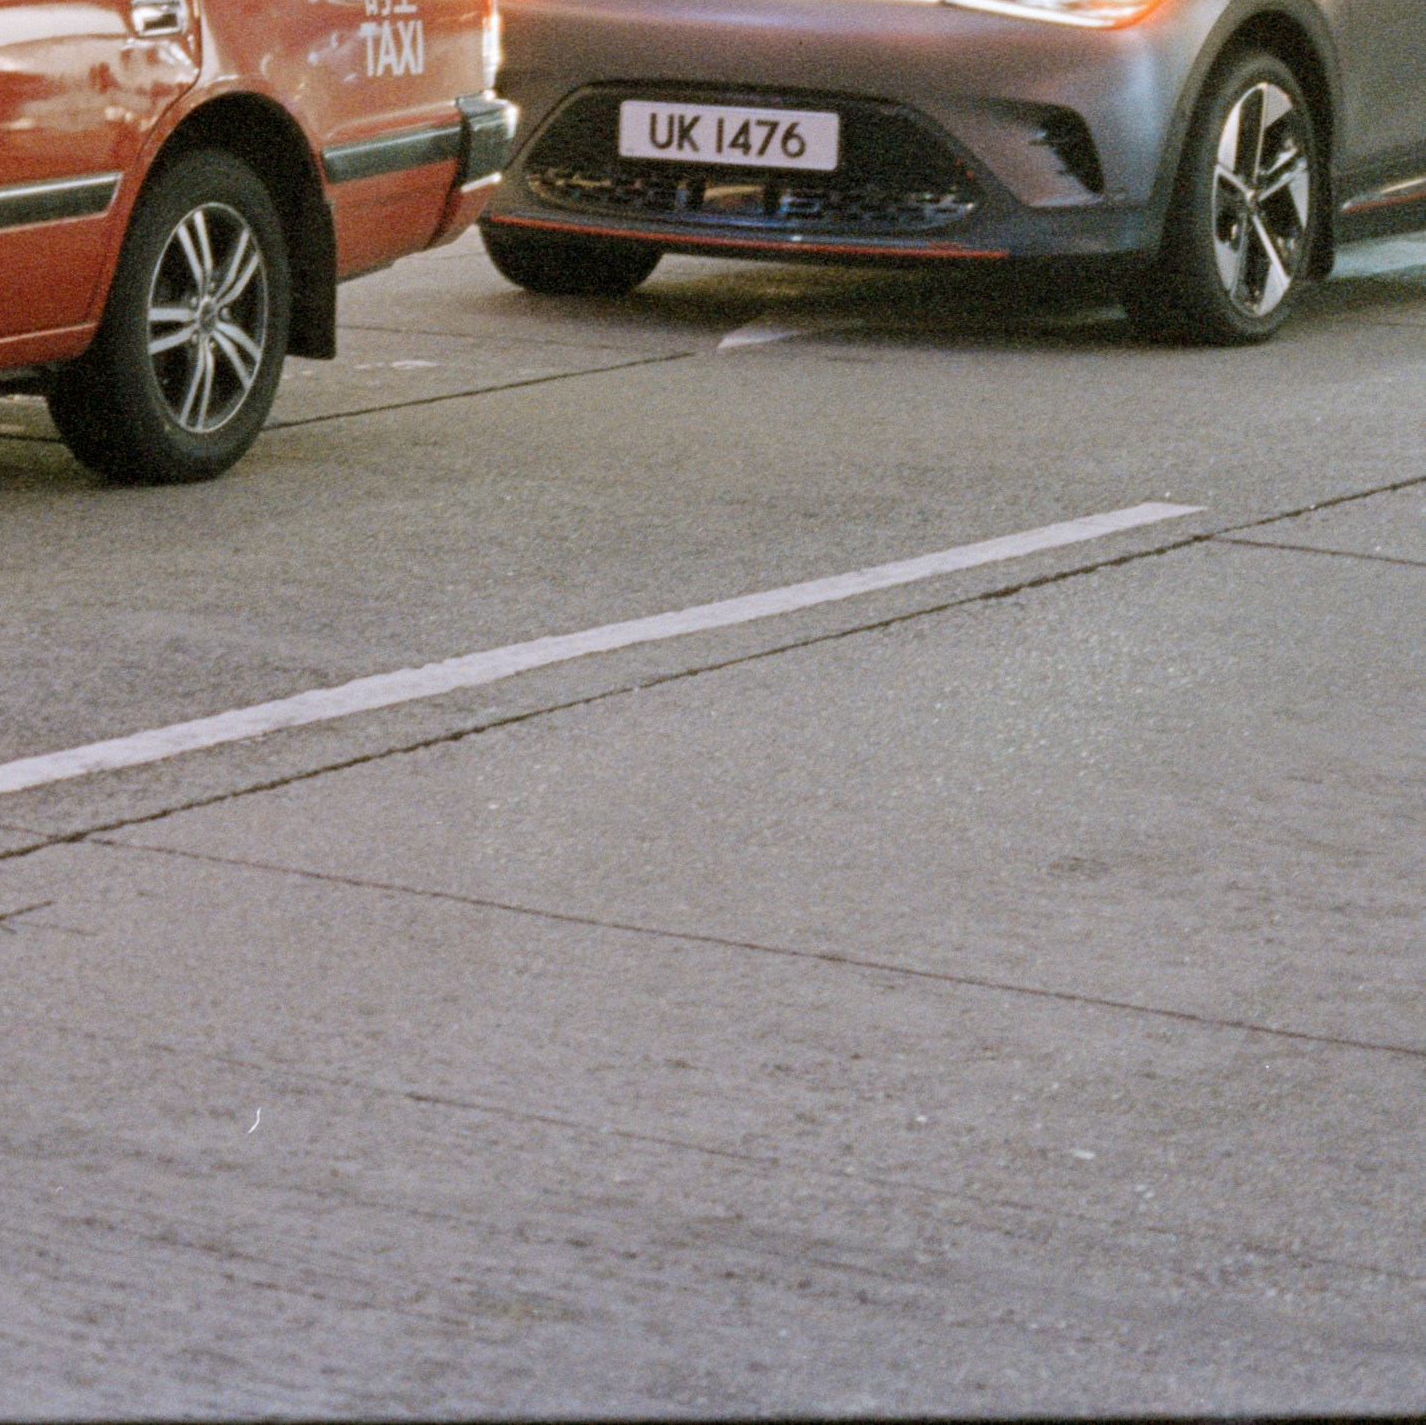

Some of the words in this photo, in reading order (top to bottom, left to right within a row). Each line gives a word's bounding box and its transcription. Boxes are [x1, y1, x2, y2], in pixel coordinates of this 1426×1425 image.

[359, 20, 425, 78] TAXI
[649, 111, 705, 152] UK
[714, 114, 807, 159] 1476
